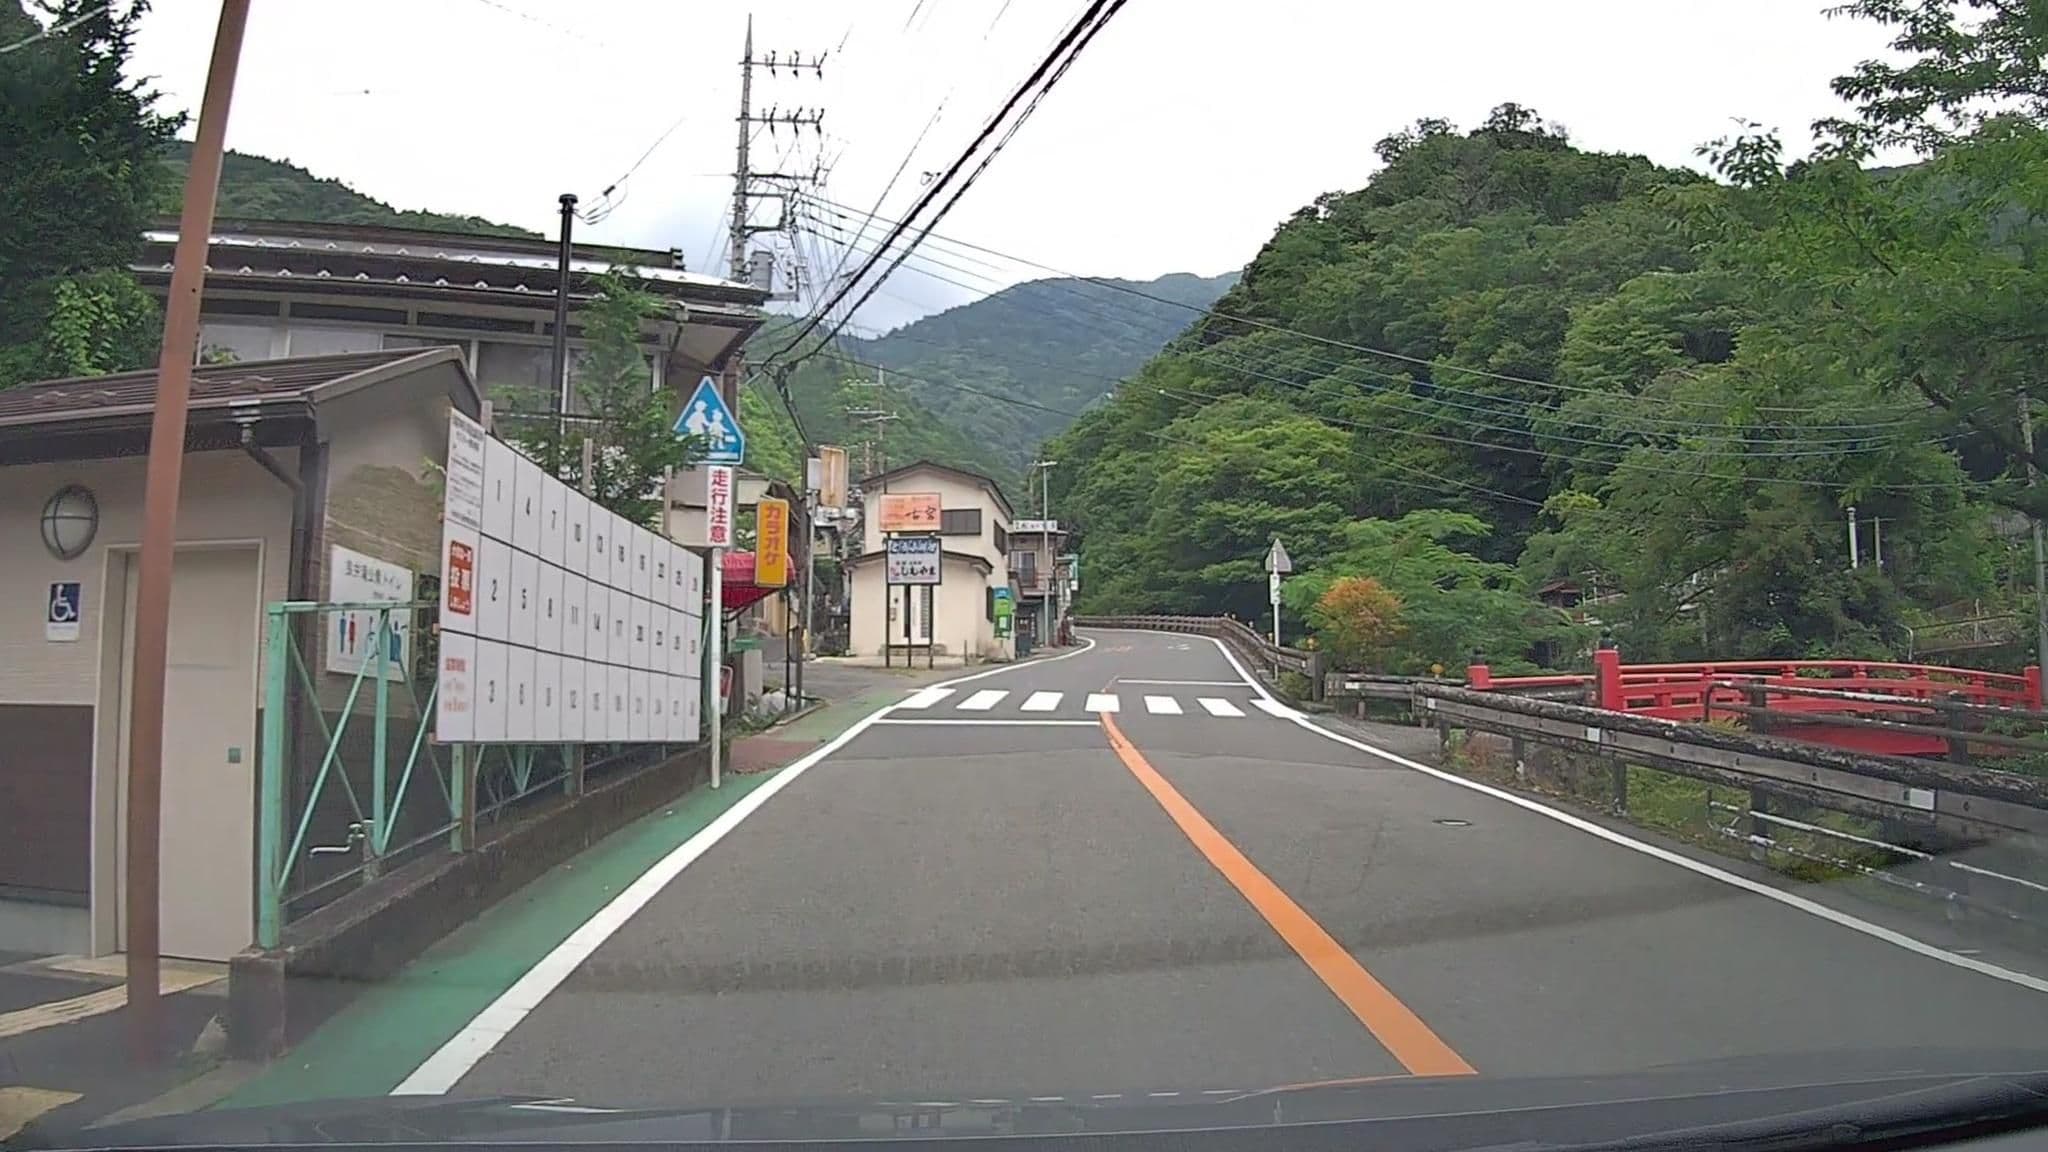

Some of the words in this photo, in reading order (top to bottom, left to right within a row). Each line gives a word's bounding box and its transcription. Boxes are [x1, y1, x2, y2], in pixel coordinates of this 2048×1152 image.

[526, 497, 531, 517] 4
[551, 510, 557, 530] 7
[710, 469, 728, 543] 走行注意
[764, 504, 781, 566] カラオケ
[491, 578, 497, 602] 2
[522, 588, 527, 610] 5
